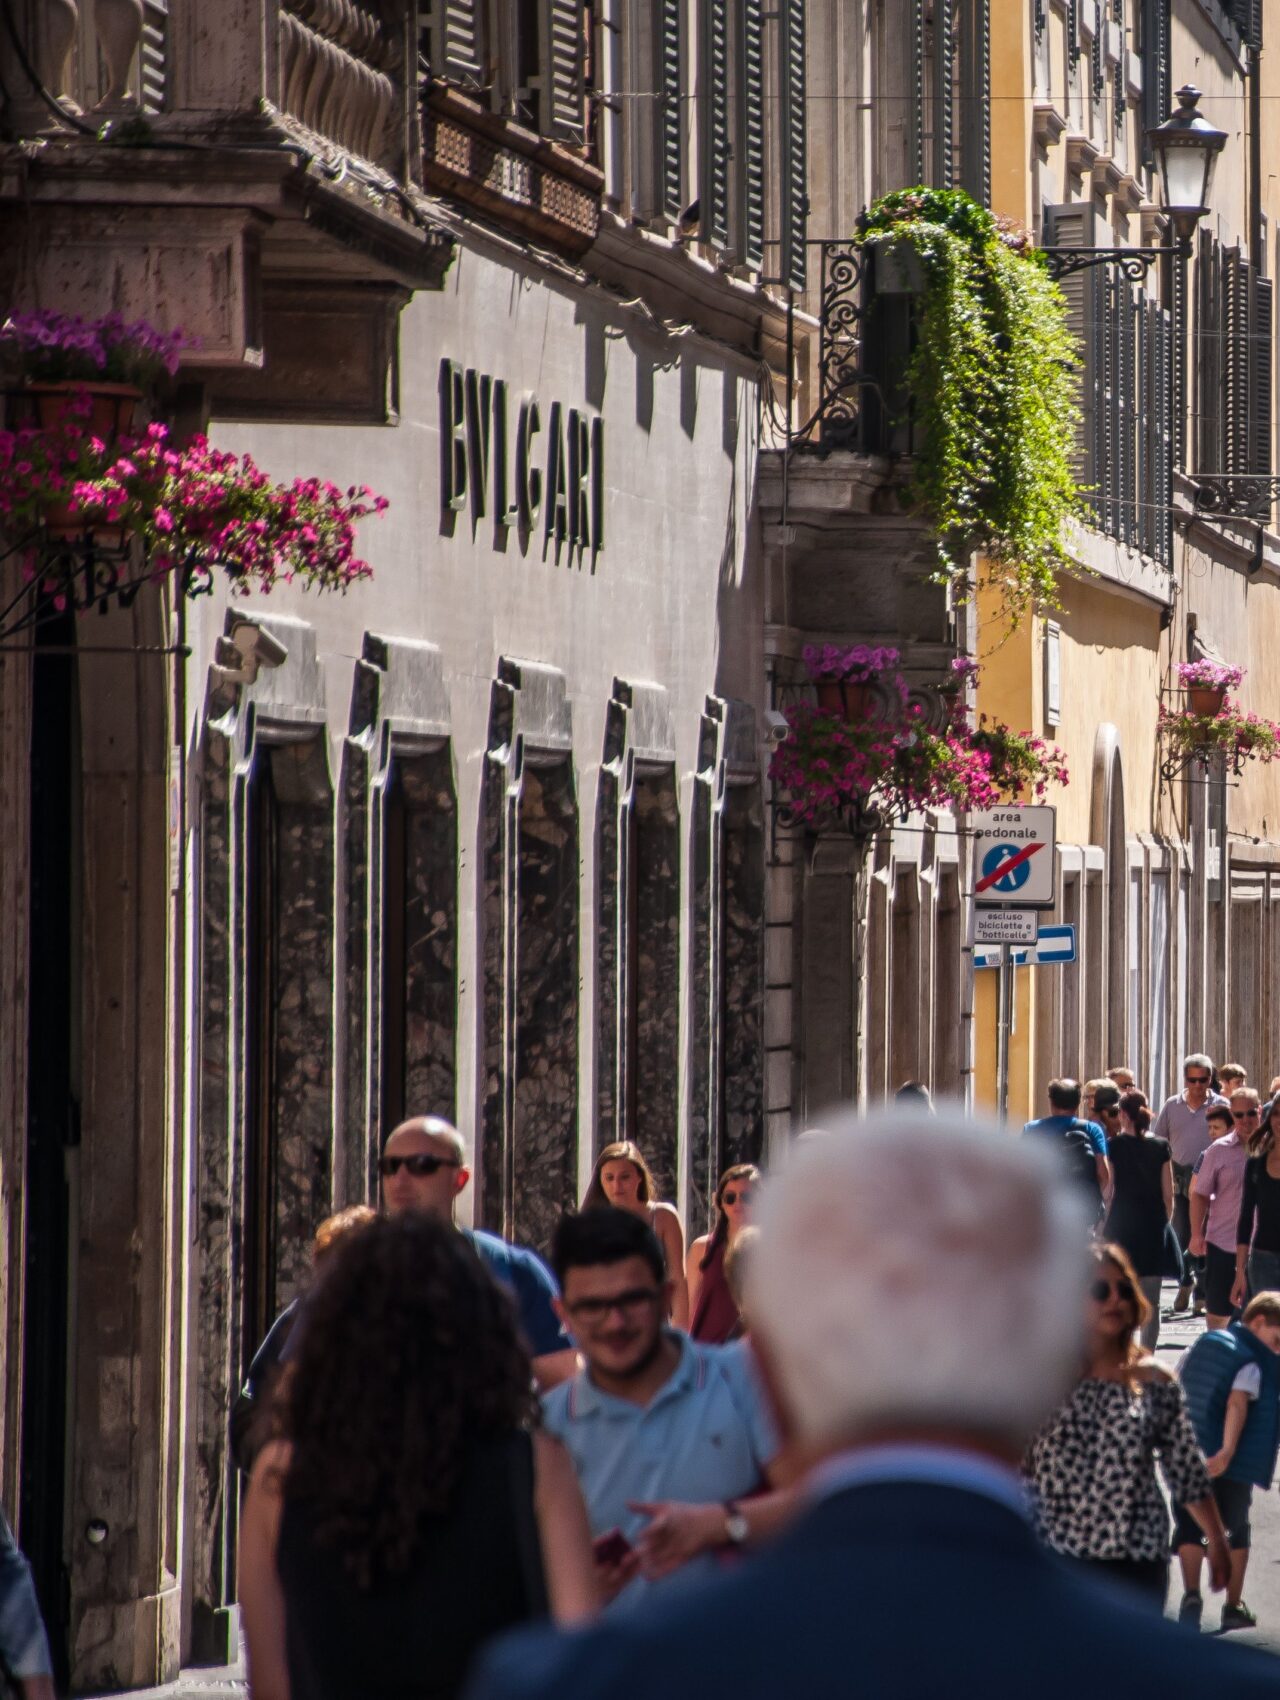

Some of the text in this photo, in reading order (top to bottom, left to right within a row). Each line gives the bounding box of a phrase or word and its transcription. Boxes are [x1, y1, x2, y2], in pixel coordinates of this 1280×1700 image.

[438, 357, 604, 551] BVLGARI
[992, 813, 1022, 822] area
[978, 921, 1023, 930] biciclette
